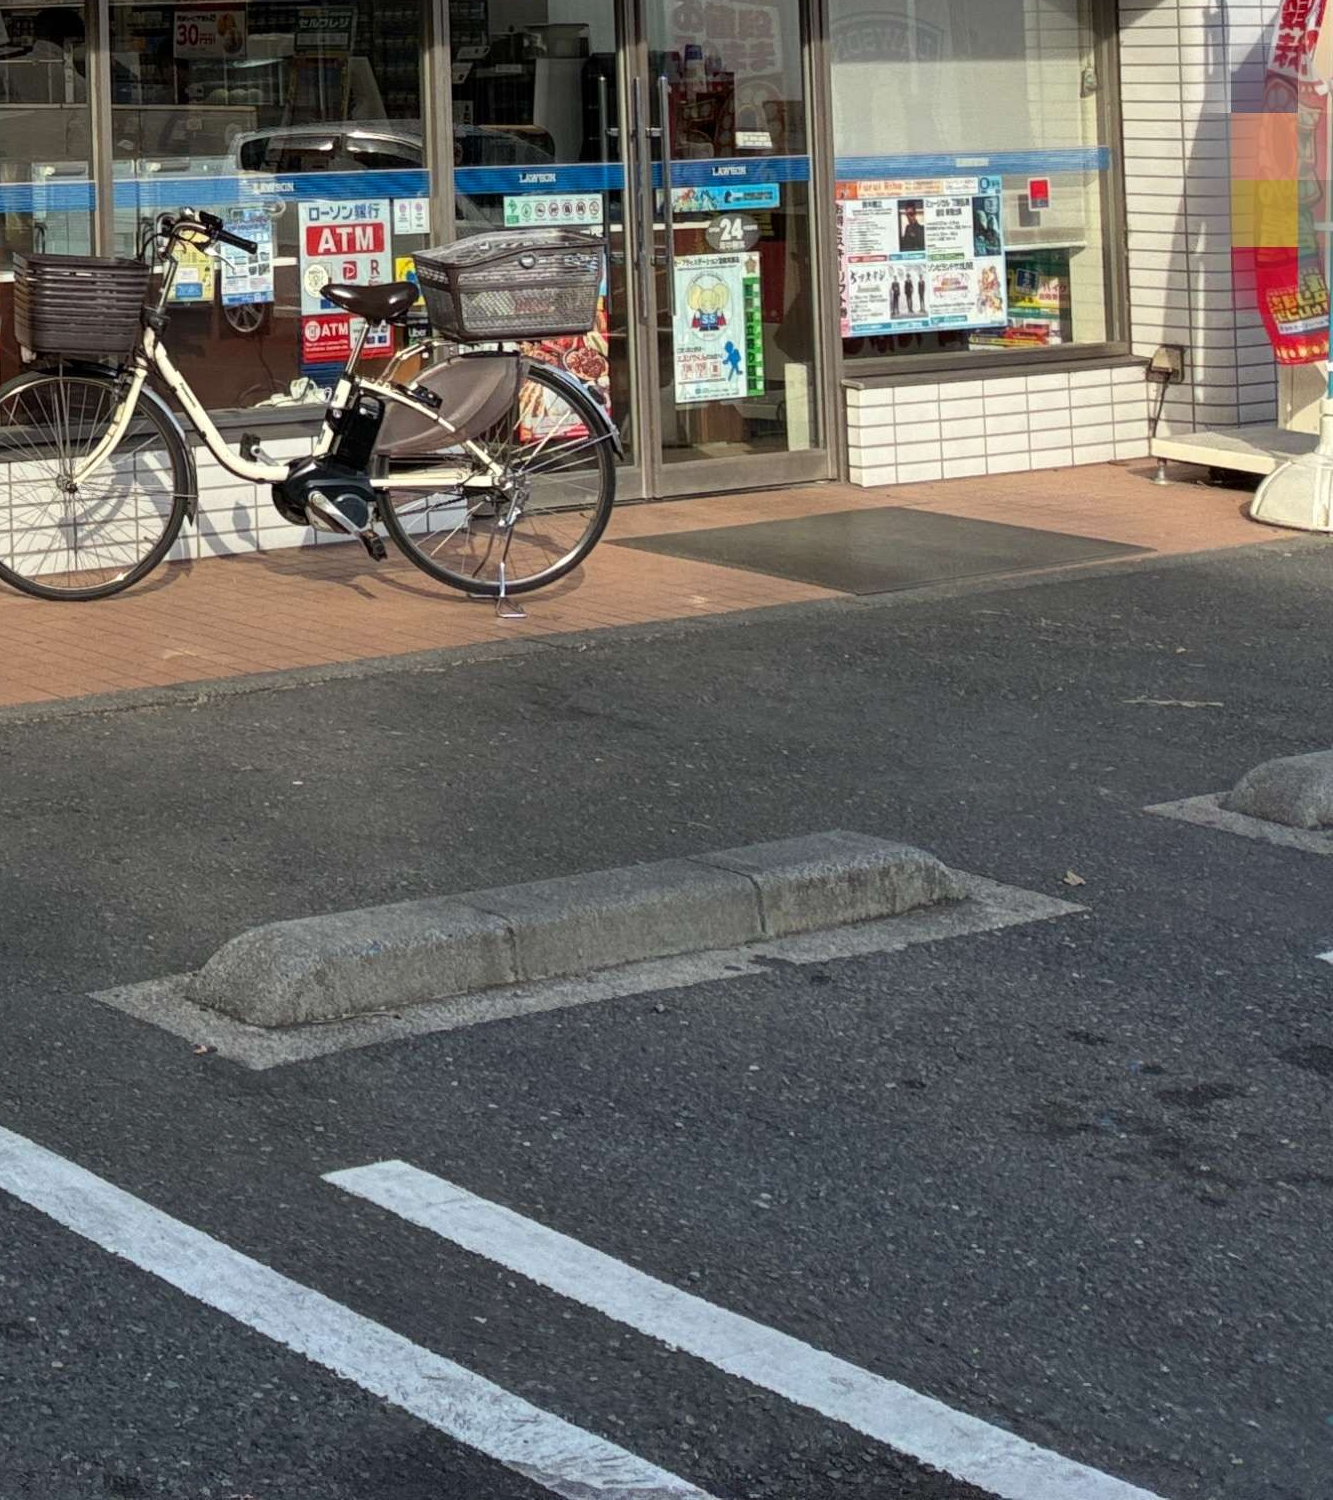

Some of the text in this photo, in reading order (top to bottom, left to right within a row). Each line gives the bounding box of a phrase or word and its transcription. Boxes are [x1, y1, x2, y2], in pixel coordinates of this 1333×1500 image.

[518, 172, 557, 184] LAWSON
[711, 165, 748, 177] LAWSON
[308, 203, 381, 222] ローソン銀行
[720, 217, 744, 241] 24
[317, 225, 375, 254] ATM
[321, 321, 349, 337] ATM
